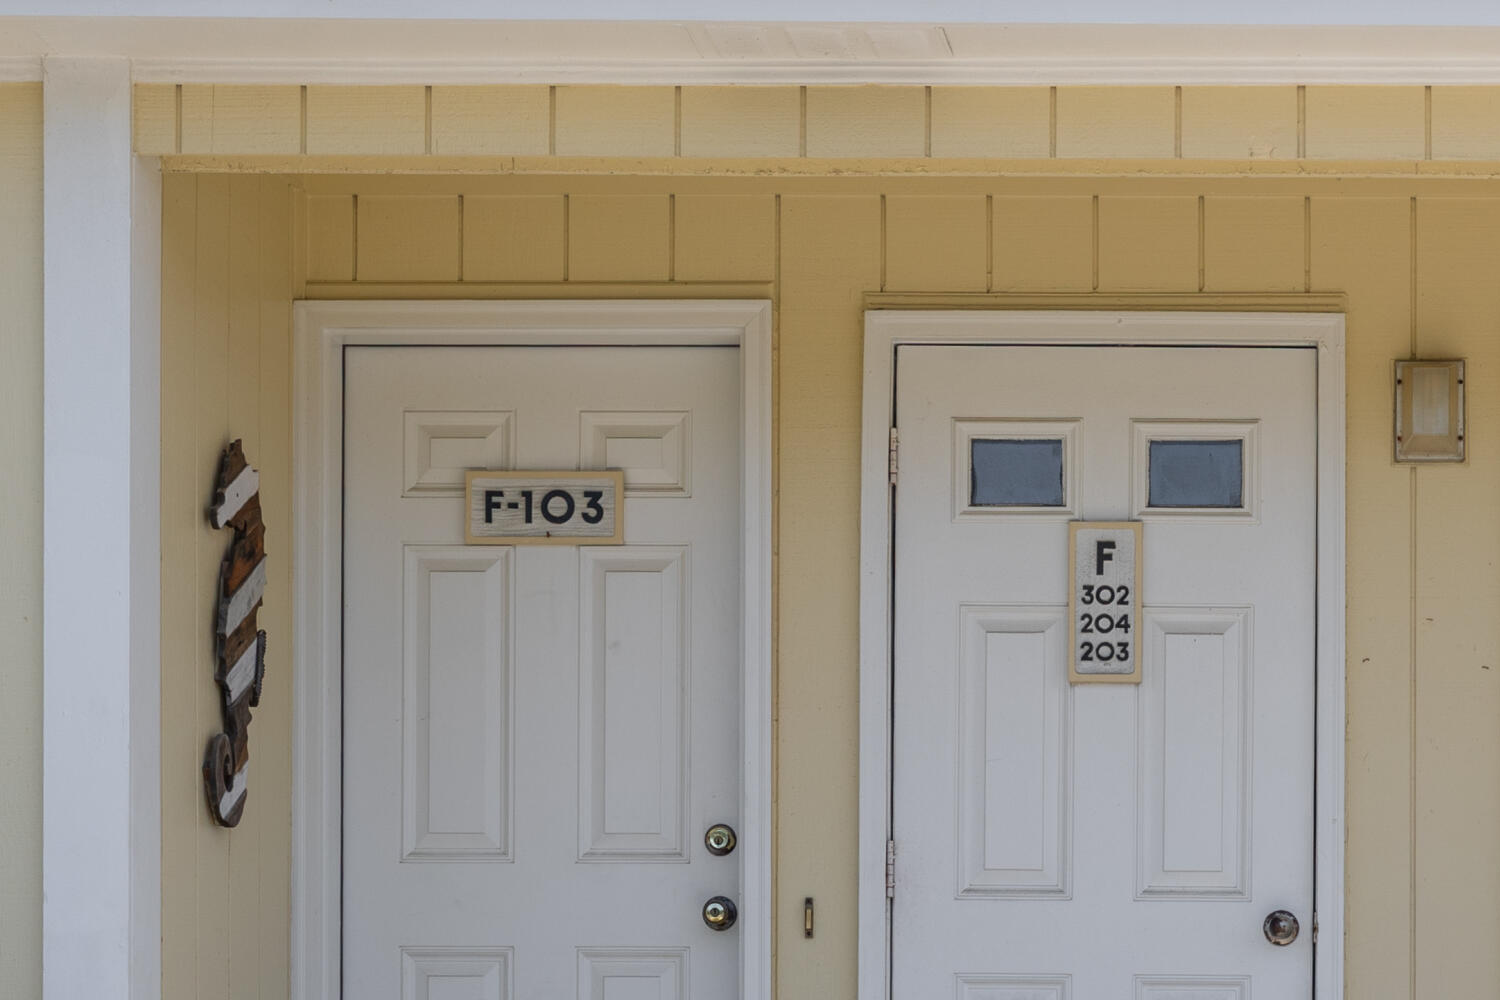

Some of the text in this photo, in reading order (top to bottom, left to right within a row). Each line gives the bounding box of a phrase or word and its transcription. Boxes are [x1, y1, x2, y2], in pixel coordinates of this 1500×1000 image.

[483, 489, 605, 525] F-103
[1095, 539, 1117, 576] F
[1080, 584, 1130, 606] 302
[1079, 612, 1131, 635] 204
[1079, 641, 1130, 662] 203
